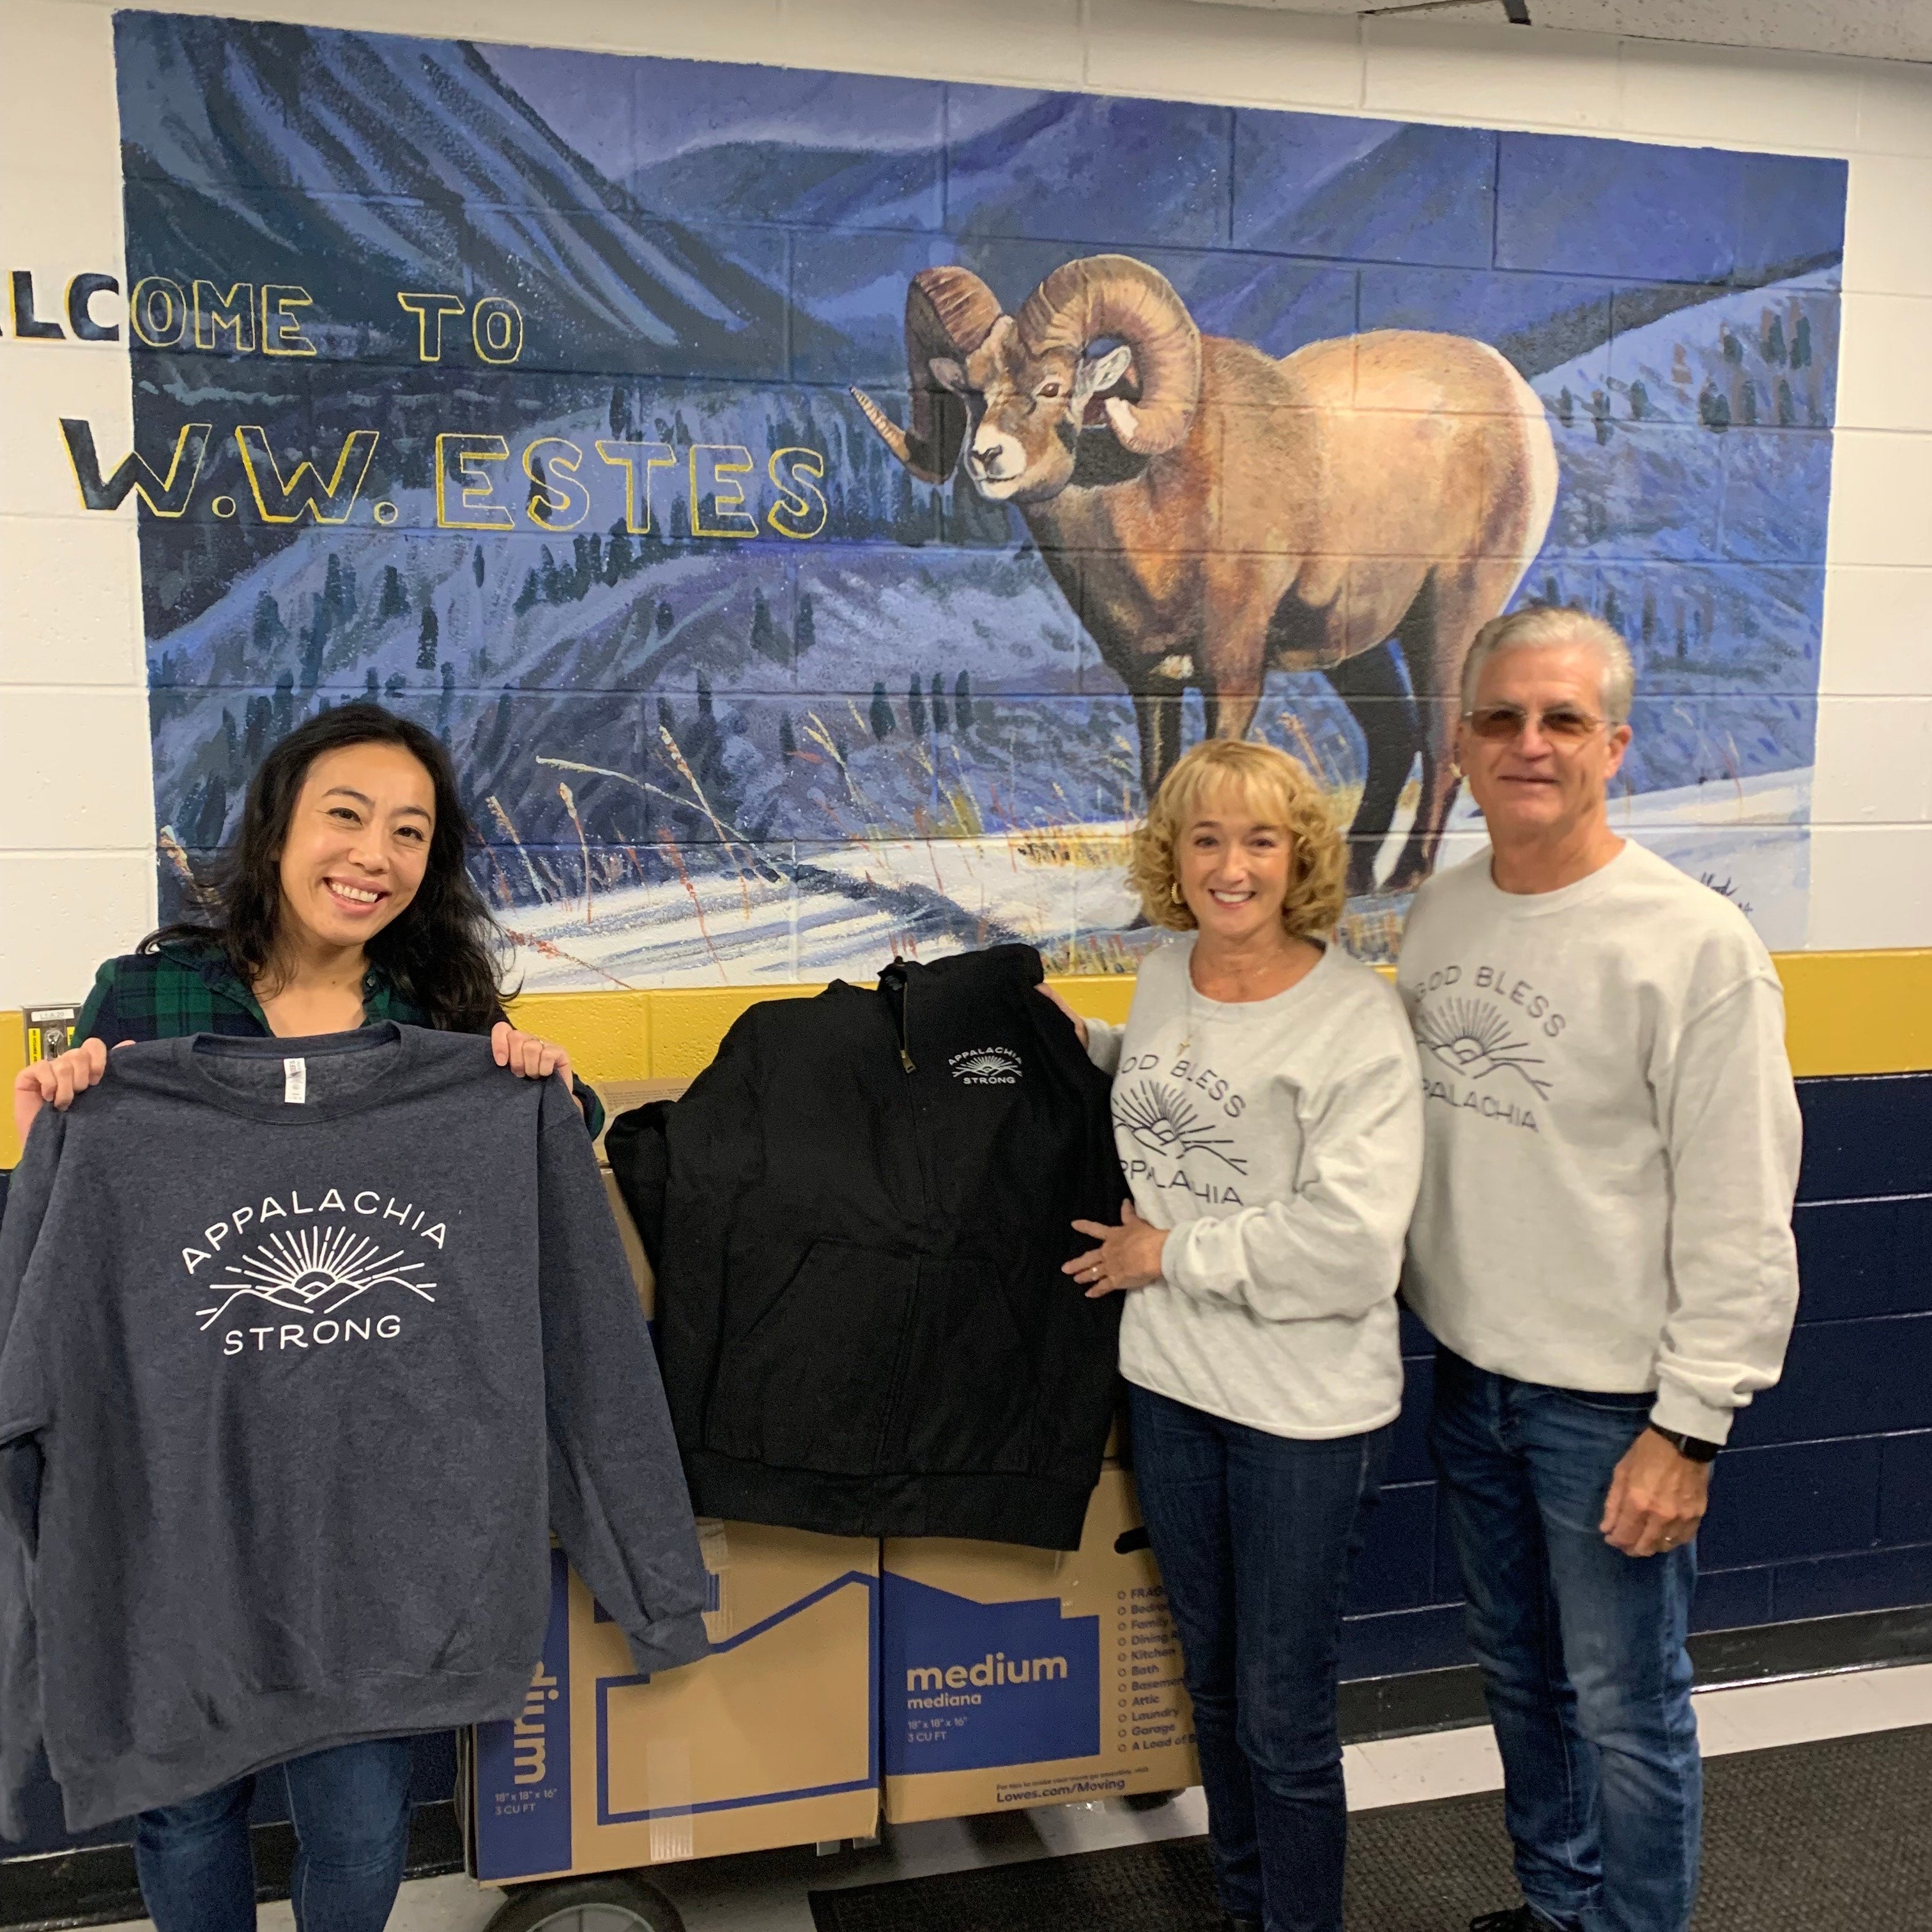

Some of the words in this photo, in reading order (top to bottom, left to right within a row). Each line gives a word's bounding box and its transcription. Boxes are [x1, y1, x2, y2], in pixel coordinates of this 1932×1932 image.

[0, 269, 318, 356] LCOME
[397, 291, 524, 364] TO
[59, 417, 399, 525] W.W.
[436, 433, 827, 539] ESTES
[1475, 965, 1566, 1038] BLESS
[948, 1047, 1022, 1066] APPALACHIA
[1121, 1054, 1159, 1074] OD
[1170, 1060, 1246, 1118] BLESS
[182, 1188, 446, 1275] APPALACHIA
[223, 1314, 401, 1356] STRONG
[907, 1652, 1068, 1691] medium
[1131, 1665, 1160, 1676] Bath
[907, 1692, 981, 1709] mediana
[1132, 1696, 1160, 1706] Attic
[514, 1660, 559, 1784] dium
[1131, 1708, 1179, 1722] Laundry
[908, 1733, 914, 1743] 3
[916, 1732, 932, 1742] CU
[934, 1731, 947, 1741] FT
[1132, 1724, 1176, 1736] Garage
[1132, 1742, 1140, 1751] A
[996, 1779, 1126, 1803] Lowes.com/Moving
[503, 1804, 520, 1814] CU
[523, 1802, 535, 1813] FT
